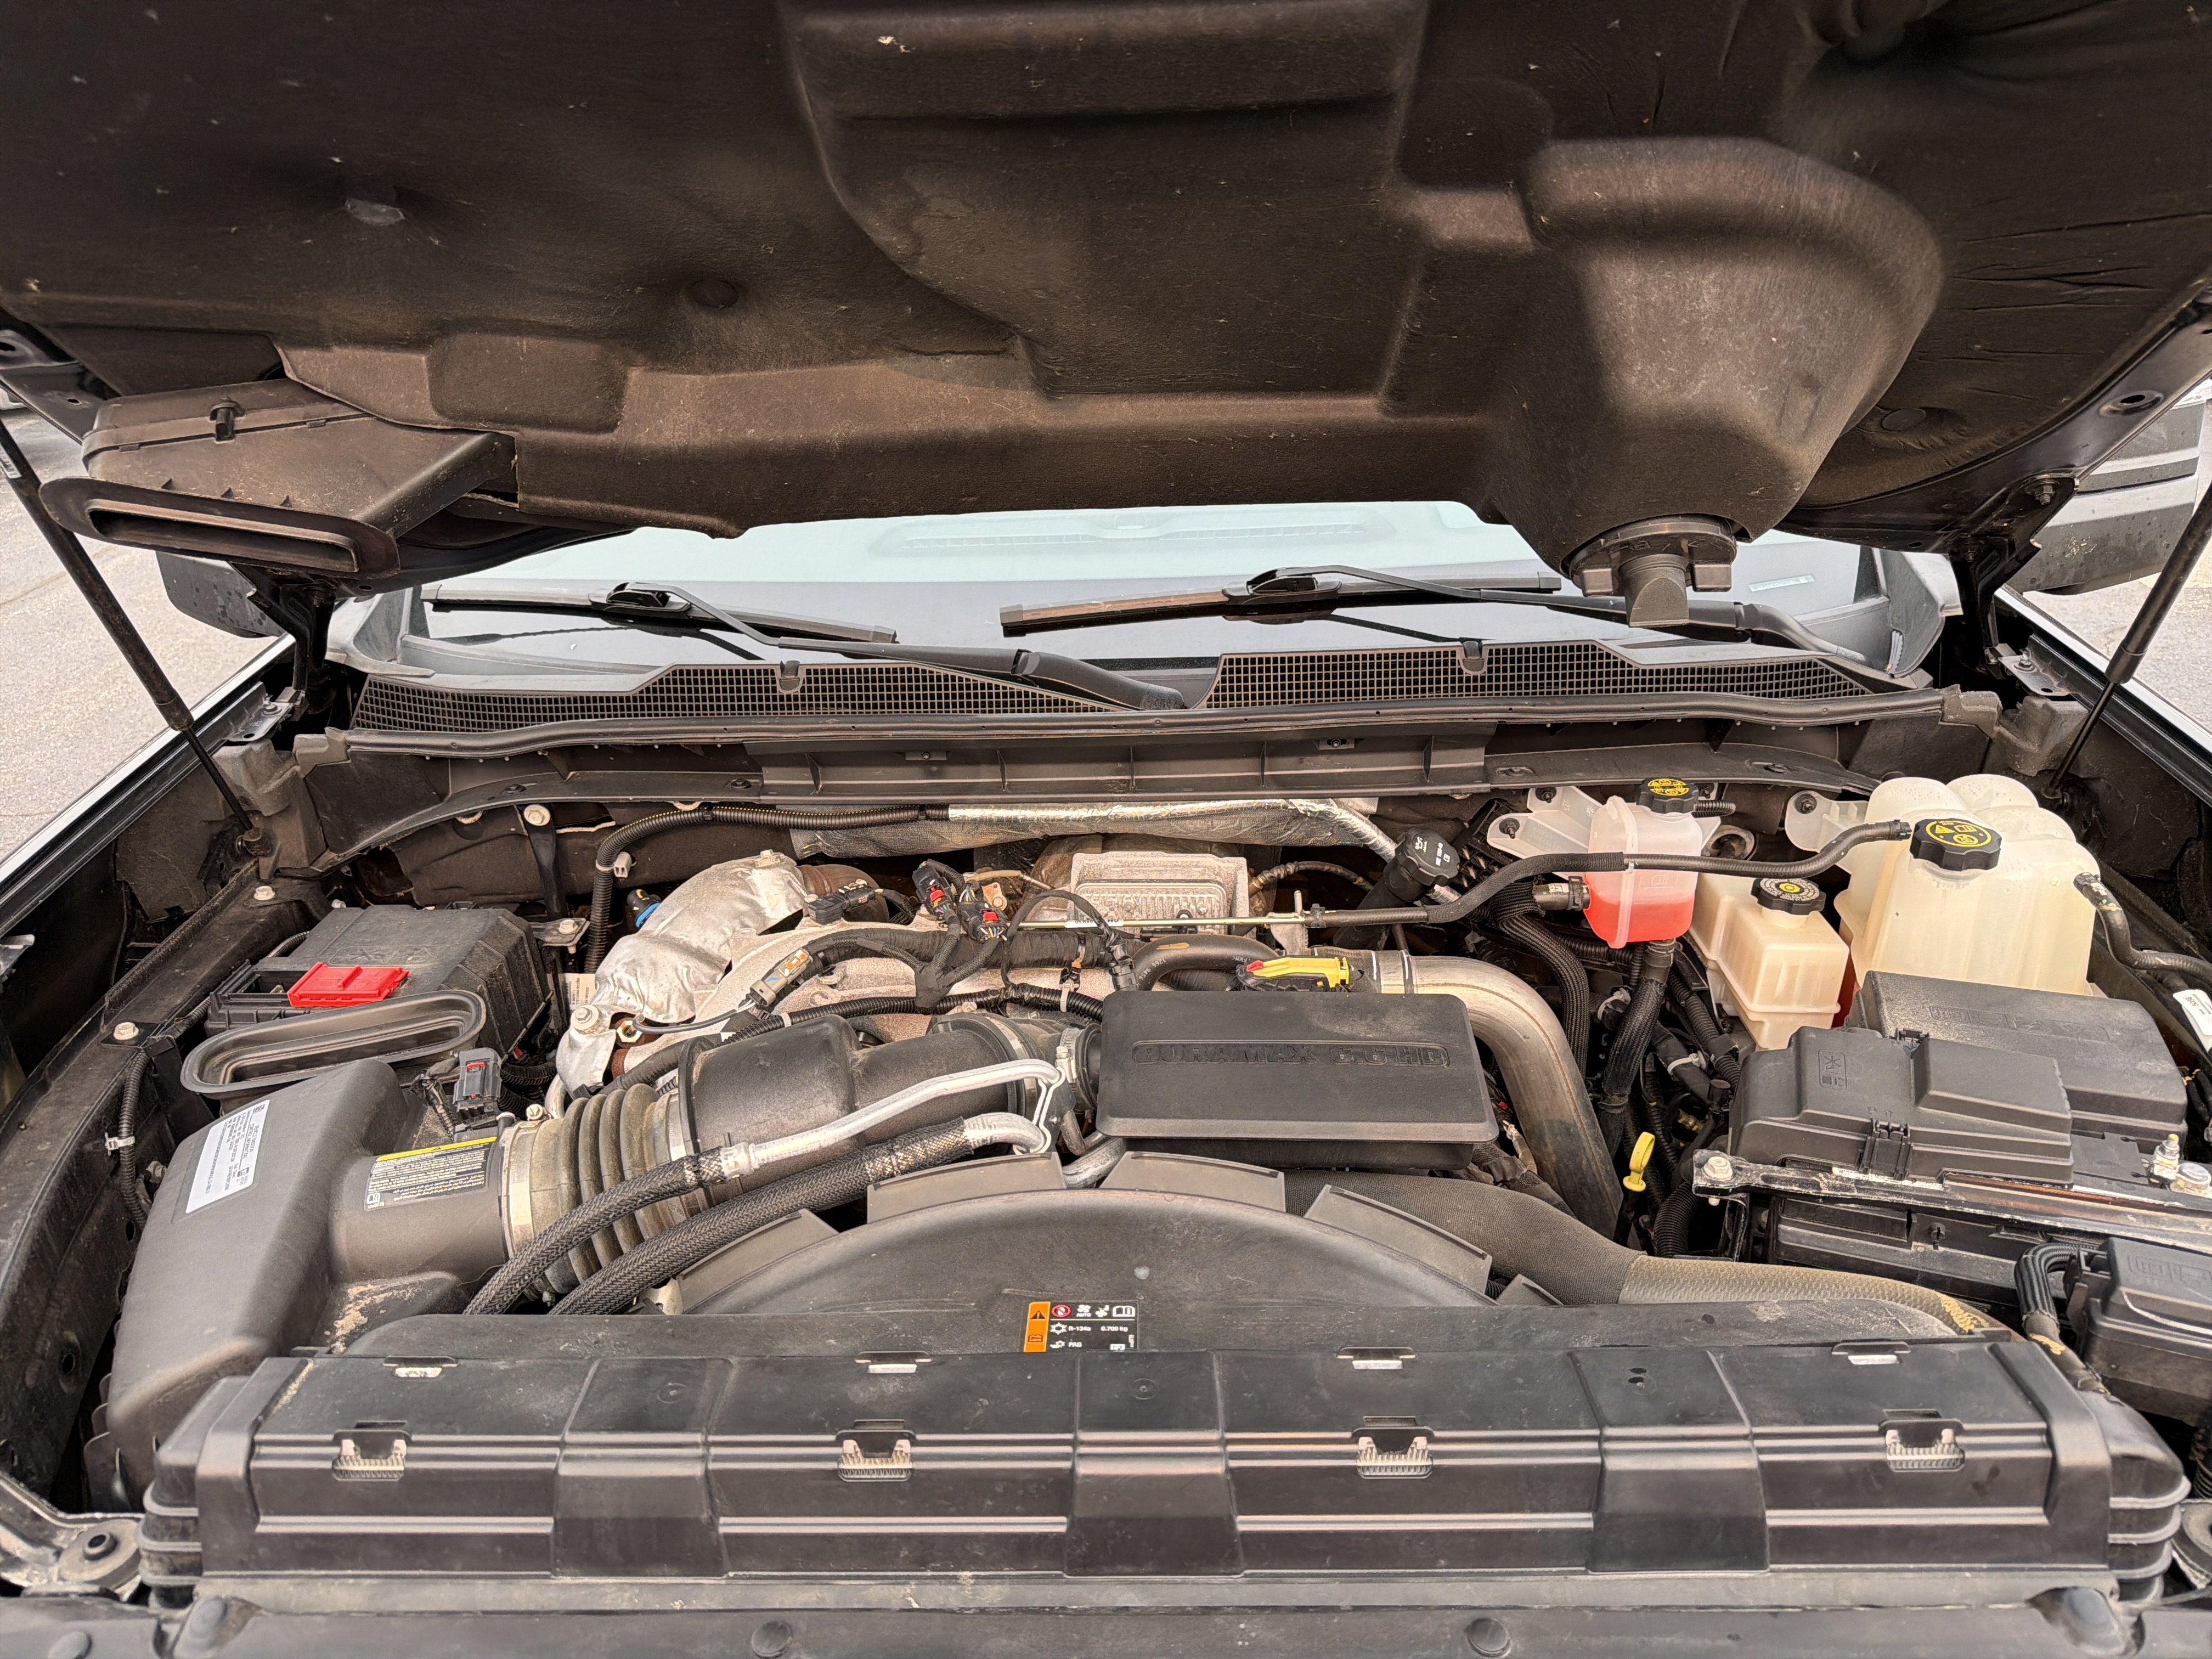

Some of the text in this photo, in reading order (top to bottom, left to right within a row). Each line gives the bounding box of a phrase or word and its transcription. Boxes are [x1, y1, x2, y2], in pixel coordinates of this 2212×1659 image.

[1138, 958, 1166, 980] 1266 9456
[1132, 1043, 1450, 1066] DURAMAX 6.6 HD
